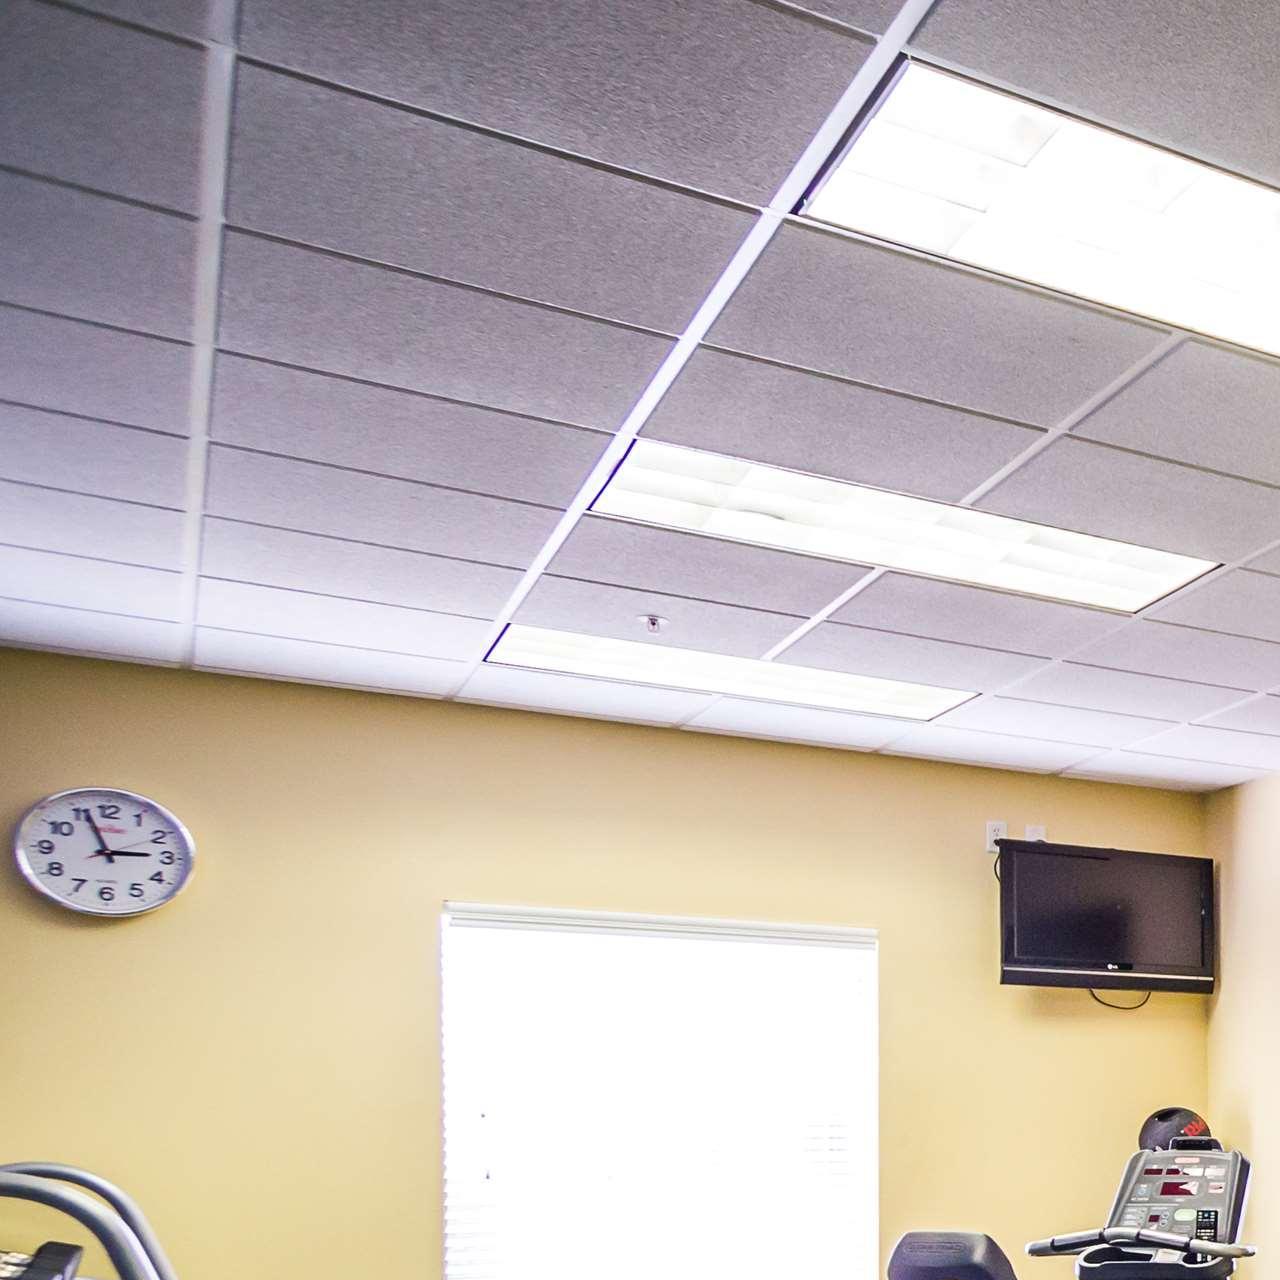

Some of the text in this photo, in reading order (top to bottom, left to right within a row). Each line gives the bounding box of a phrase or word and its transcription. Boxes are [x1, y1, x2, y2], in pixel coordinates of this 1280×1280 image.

[97, 804, 121, 820] 12
[133, 813, 144, 828] 1
[48, 821, 75, 837] 10
[151, 829, 167, 845] 2
[38, 839, 55, 855] 9
[159, 850, 176, 866] 3
[48, 861, 64, 877] 8
[71, 877, 89, 893] 7
[149, 870, 165, 885] 4
[98, 886, 115, 902] 6
[129, 882, 145, 898] 5
